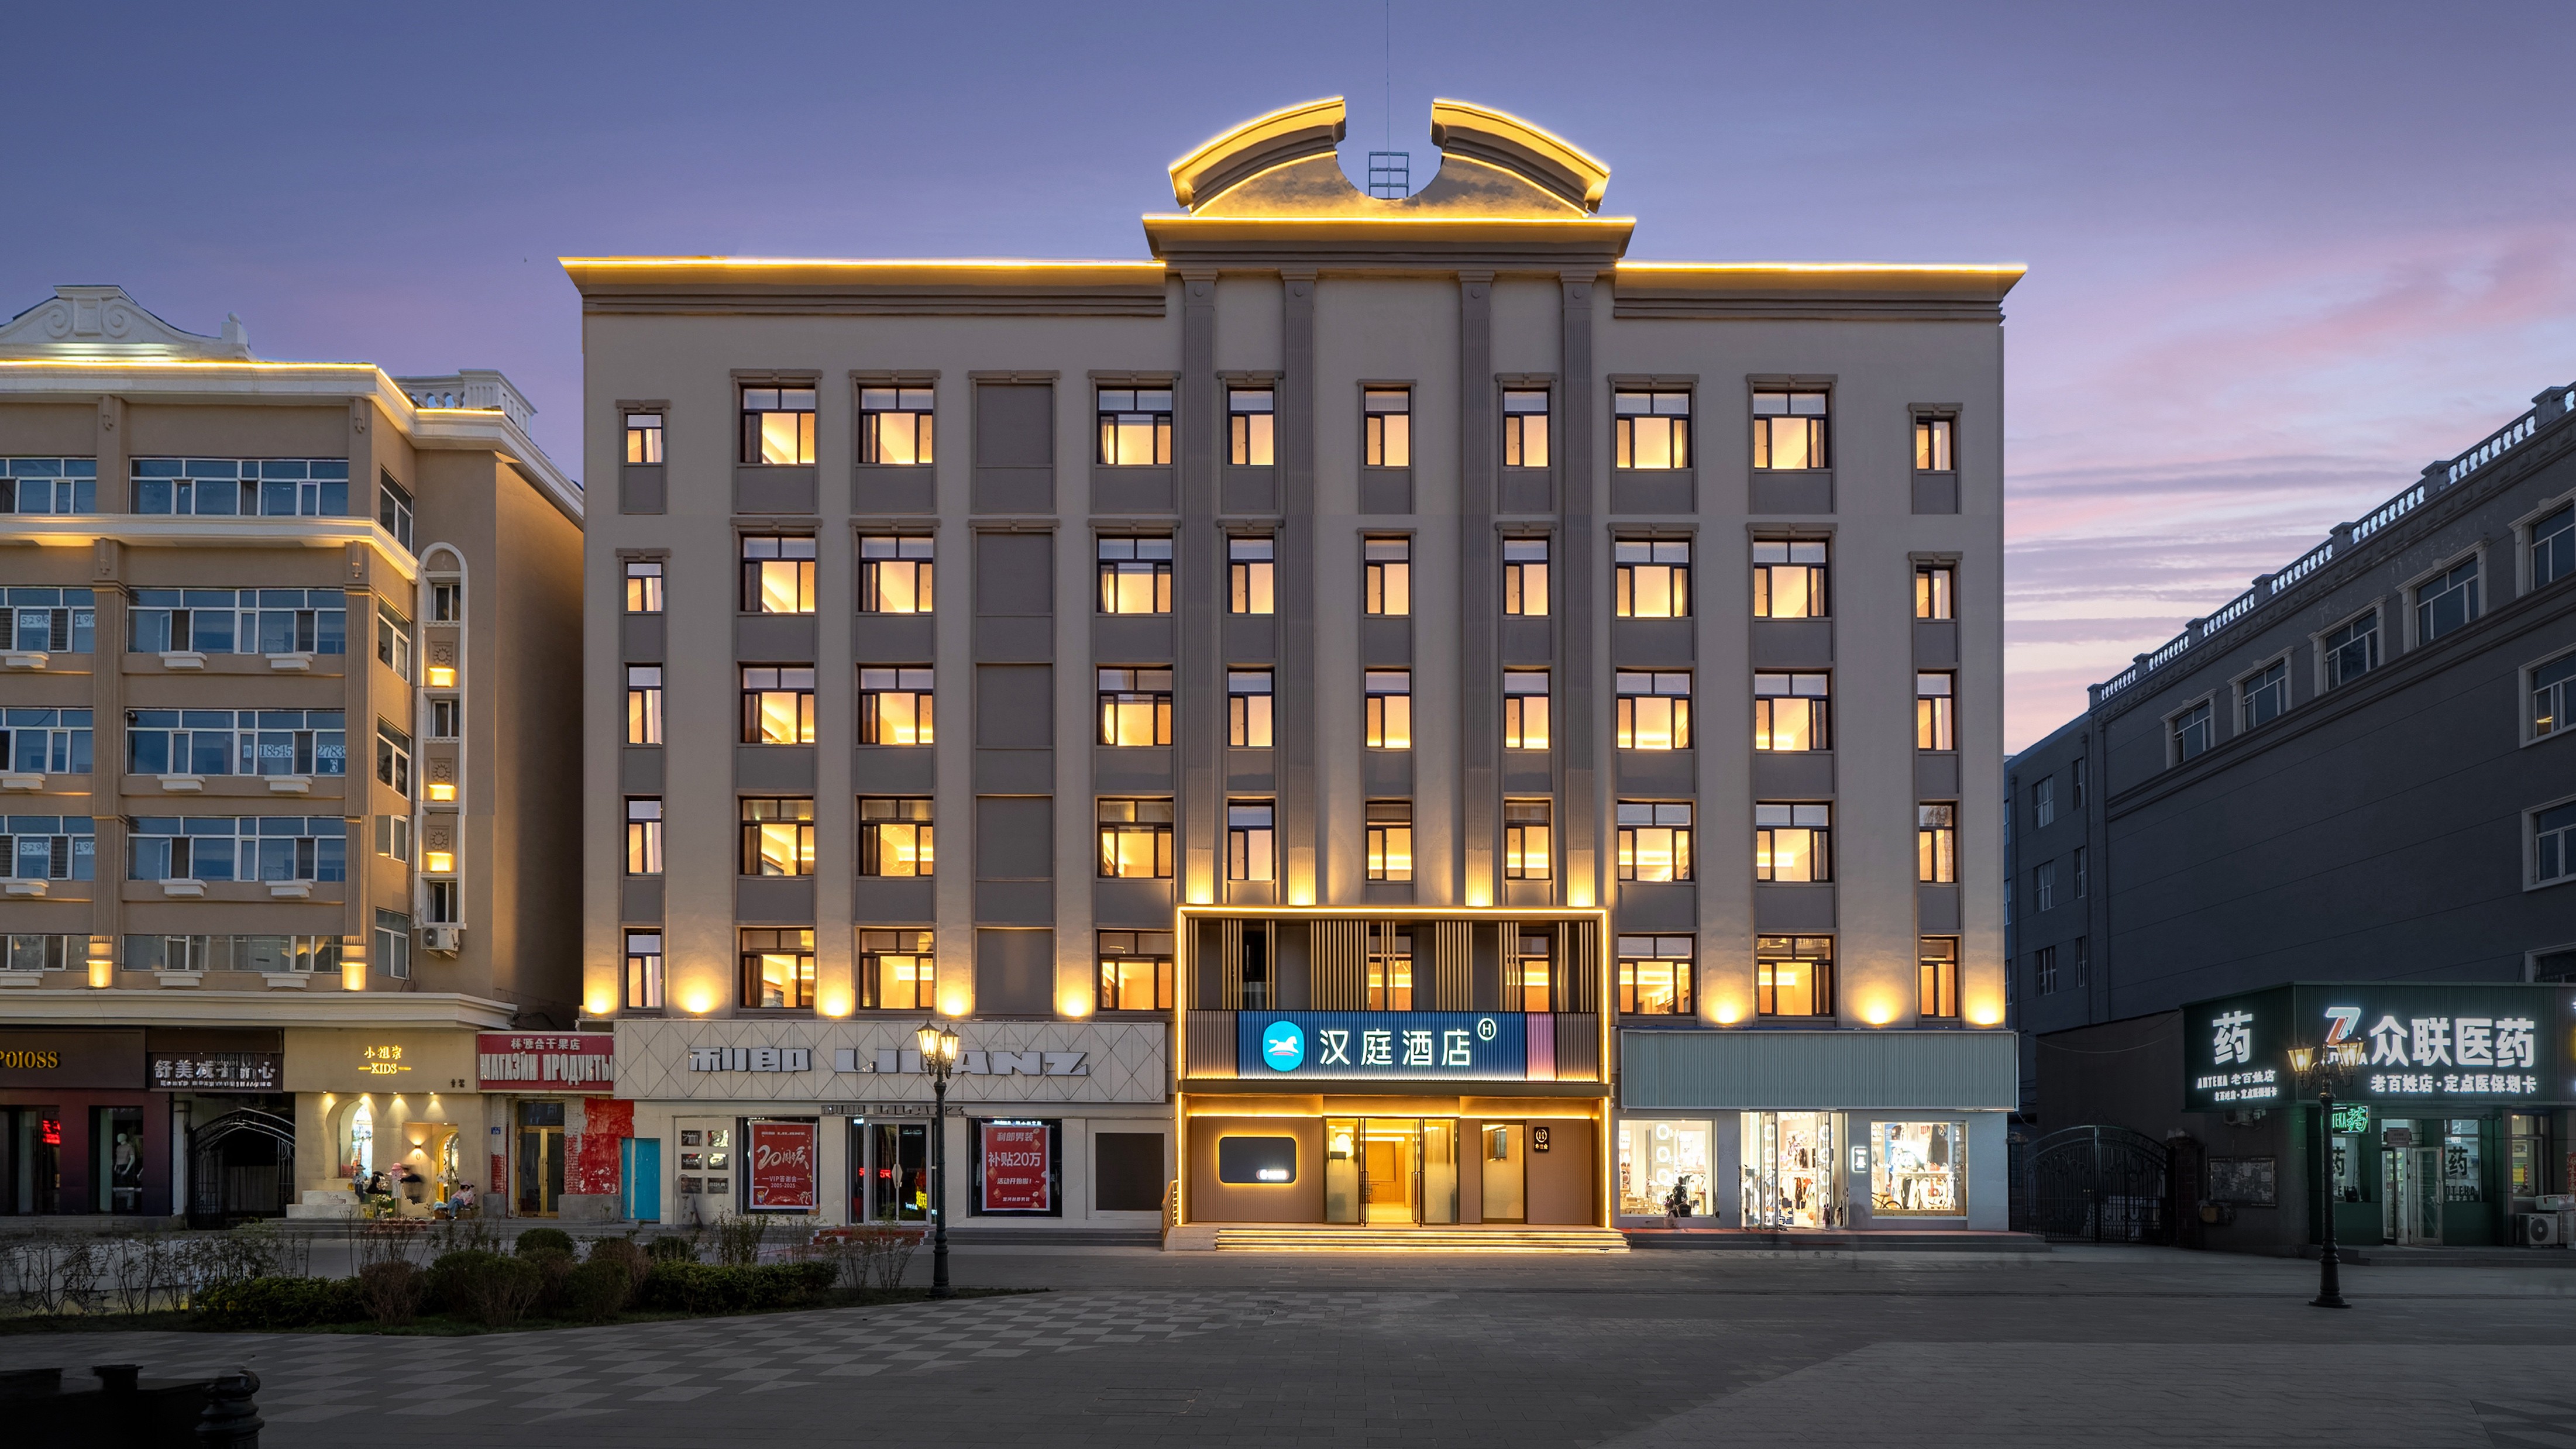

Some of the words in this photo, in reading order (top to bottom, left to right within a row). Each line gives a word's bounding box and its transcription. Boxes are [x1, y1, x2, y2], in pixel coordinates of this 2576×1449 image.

[318, 745, 345, 757] 2783
[1320, 1028, 1471, 1066] 汉庭酒店
[2213, 1010, 2253, 1065] 药
[2370, 1016, 2534, 1068] 众联医药
[364, 1046, 402, 1060] 小祖宗
[835, 1049, 1089, 1076] LILANZ
[371, 1063, 397, 1074] KIDS
[997, 1132, 1034, 1141] 利郎男装
[988, 1152, 1041, 1166] 补贴20万
[2447, 1146, 2468, 1176] 药
